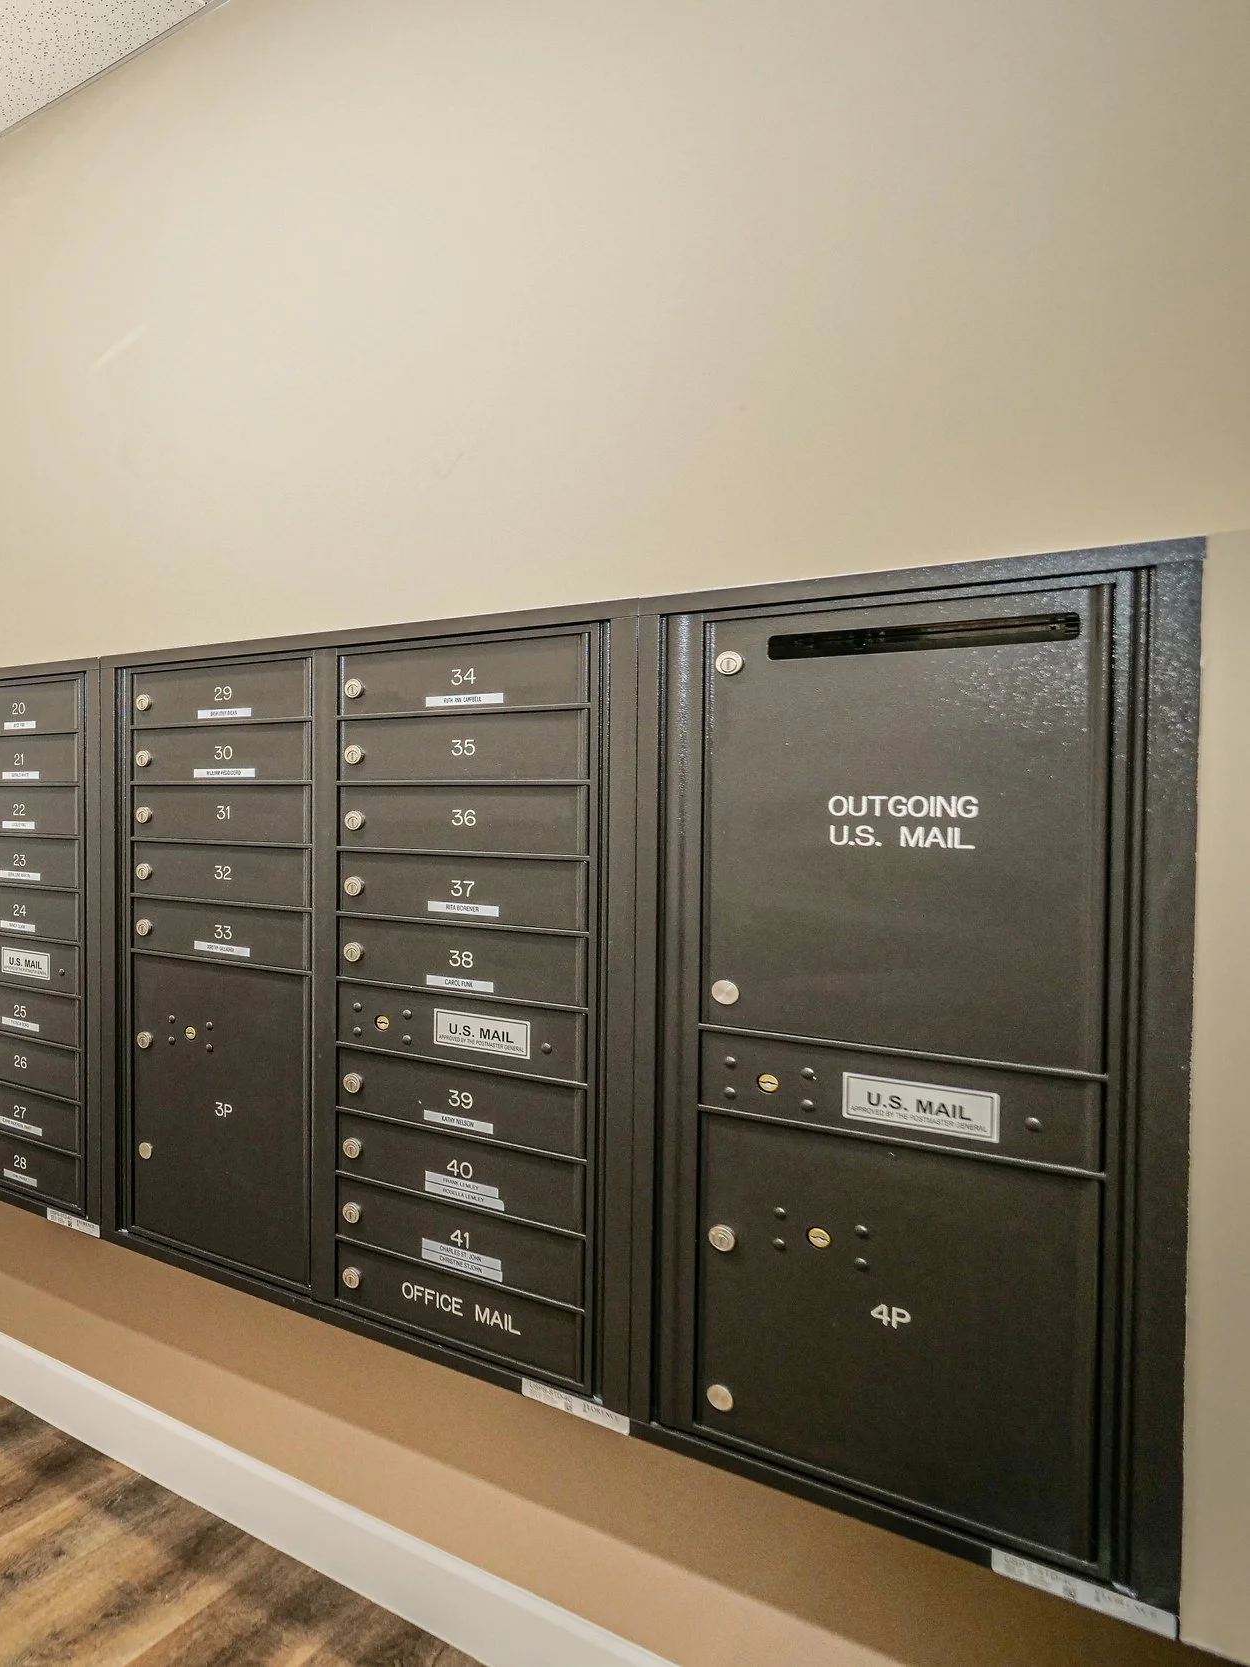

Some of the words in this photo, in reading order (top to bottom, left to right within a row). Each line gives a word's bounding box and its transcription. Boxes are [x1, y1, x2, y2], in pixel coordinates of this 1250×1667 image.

[451, 668, 476, 685] 34
[215, 686, 232, 701] 29
[11, 702, 26, 715] 20
[214, 746, 232, 759] 30
[452, 740, 475, 756] 35
[13, 753, 24, 766] 21
[12, 803, 26, 816] 22
[217, 806, 230, 819] 31
[829, 796, 978, 818] OUTGOING
[452, 810, 476, 826] 36
[830, 825, 882, 846] U.S.
[900, 826, 975, 849] MAIL
[13, 853, 27, 867] 23
[215, 866, 231, 880] 32
[451, 880, 474, 897] 37
[12, 903, 27, 917] 24
[215, 925, 232, 939] 33
[9, 956, 22, 966] U.S.
[25, 959, 42, 970] MAIL
[449, 950, 473, 968] 38
[13, 1005, 27, 1018] 25
[449, 1023, 474, 1037] U.S.
[480, 1028, 514, 1043] MAIL
[439, 1034, 460, 1043] APPROVED
[476, 1040, 504, 1049] POSTMASTER
[13, 1054, 28, 1069] 26
[449, 1090, 472, 1109] 39
[867, 1091, 908, 1111] U.S.
[916, 1099, 972, 1120] MAIL
[13, 1105, 27, 1119] 27
[215, 1102, 232, 1117] 3P
[441, 1116, 455, 1124] KATHY
[456, 1119, 474, 1128] NELSON
[850, 1105, 885, 1116] APPROVED
[896, 1111, 909, 1120] THE
[910, 1114, 953, 1126] POSTMASTER
[955, 1120, 987, 1132] GENERAL
[13, 1155, 27, 1170] 28
[447, 1160, 473, 1180] 40
[443, 1177, 459, 1185] FRANK
[465, 1192, 484, 1202] LEMLEY
[449, 1229, 470, 1249] 41
[440, 1245, 460, 1256] CHARLES
[469, 1253, 482, 1262] JOHN
[440, 1255, 463, 1267] CHRISTINE
[402, 1282, 463, 1316] OFFICE
[476, 1304, 521, 1335] MAIL
[871, 1304, 911, 1329] 4P
